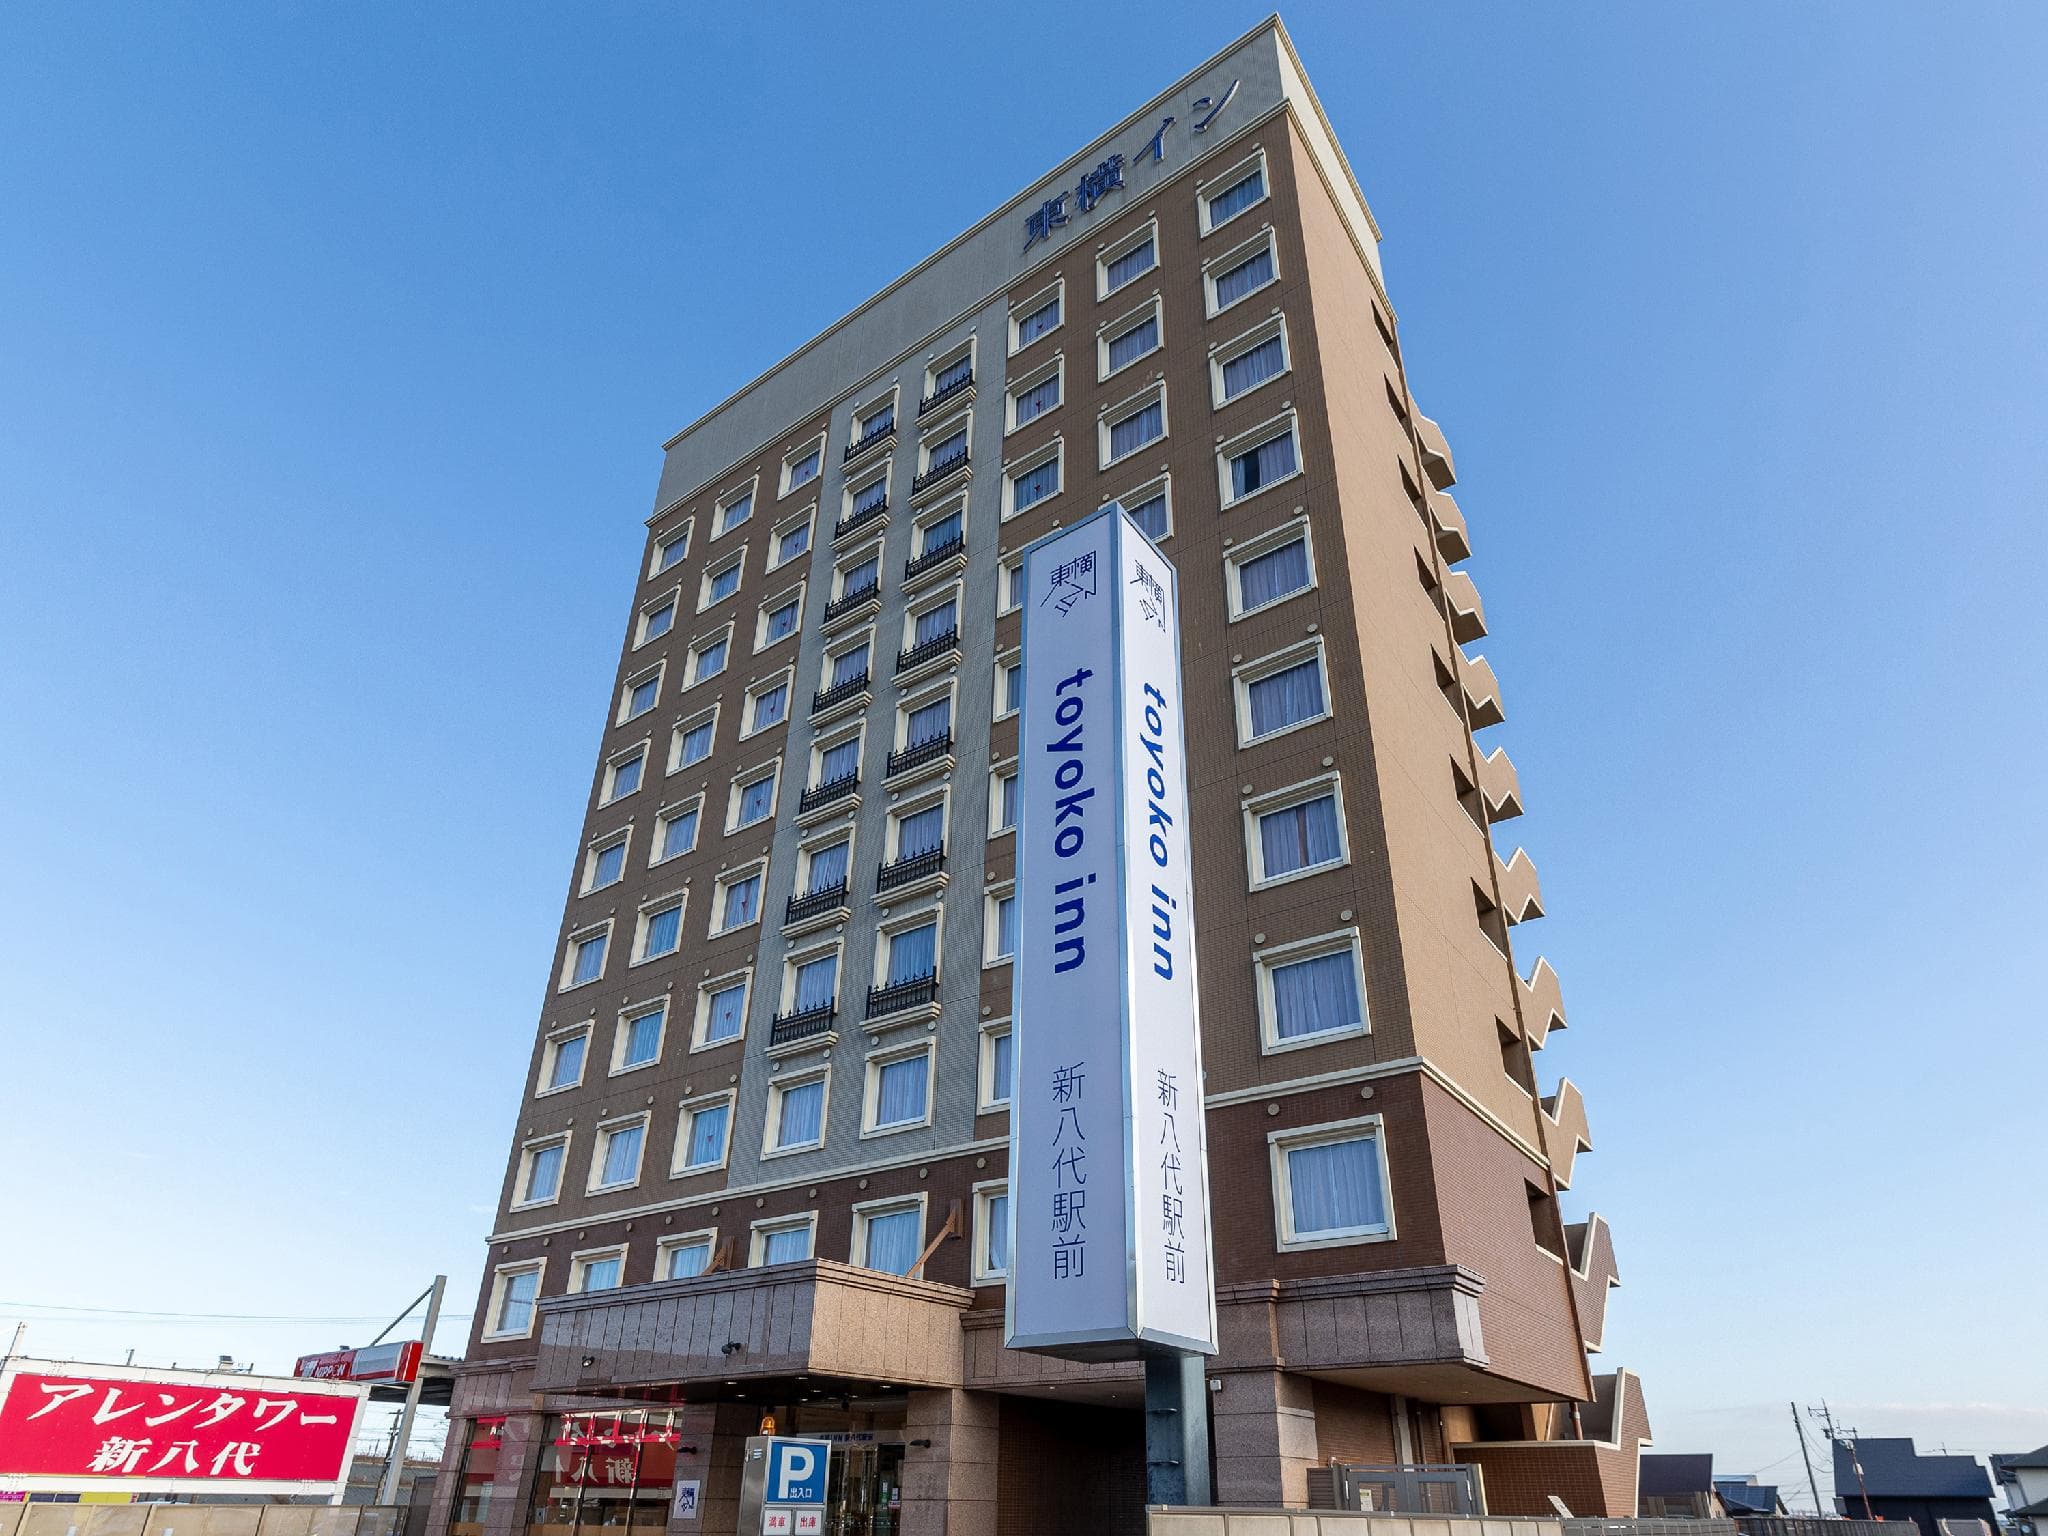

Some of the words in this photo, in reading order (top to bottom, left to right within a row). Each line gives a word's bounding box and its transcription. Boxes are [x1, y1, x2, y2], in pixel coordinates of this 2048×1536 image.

[1024, 79, 1240, 251] 東横イン
[1046, 667, 1095, 858] toyoko
[1140, 682, 1173, 867] toyoko
[1054, 873, 1096, 974] inn
[1151, 884, 1176, 981] inn
[1052, 1062, 1087, 1279] 新八代駅前
[1157, 1068, 1185, 1284] 新八代駅前
[27, 1382, 337, 1432] アレンタワー
[86, 1436, 261, 1476] 新八代
[778, 1446, 815, 1499] P
[789, 1487, 812, 1499] 出入口
[800, 1516, 817, 1528] 出庫
